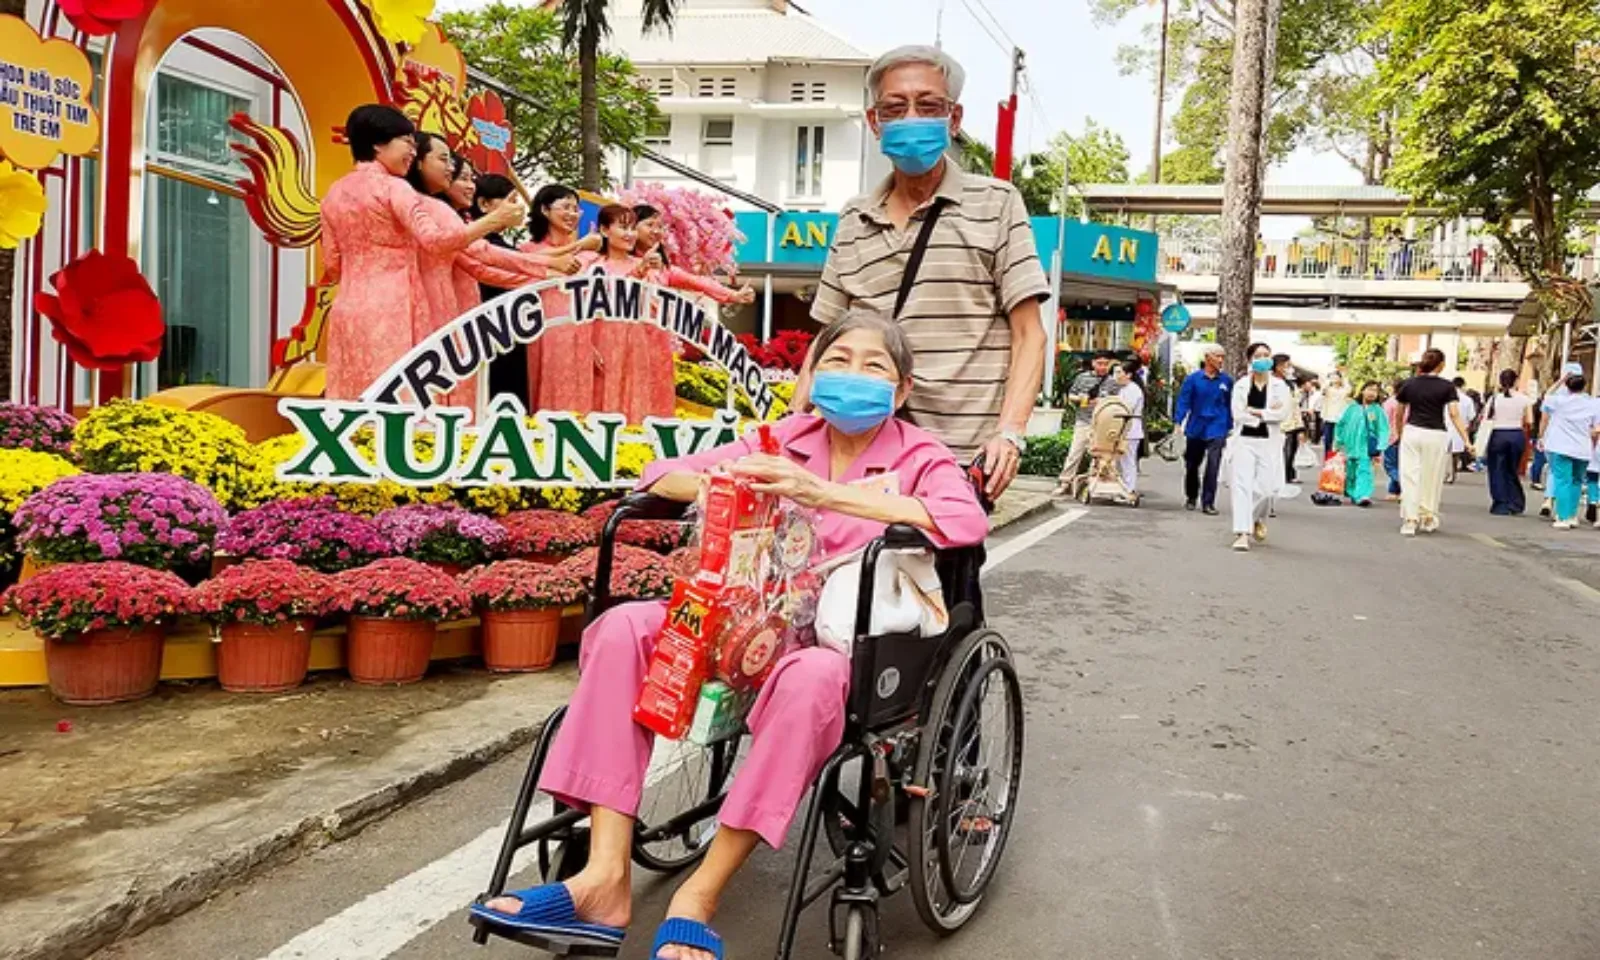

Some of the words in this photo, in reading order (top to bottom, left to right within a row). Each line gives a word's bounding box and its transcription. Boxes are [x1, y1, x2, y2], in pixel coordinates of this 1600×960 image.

[66, 103, 88, 124] TIM
[40, 119, 60, 139] EM
[780, 221, 828, 247] AN
[1091, 234, 1139, 264] AN
[374, 292, 544, 410] TRUNG
[565, 265, 642, 322] TÂM
[657, 289, 706, 344] TIM
[284, 399, 625, 482] XUÂN
